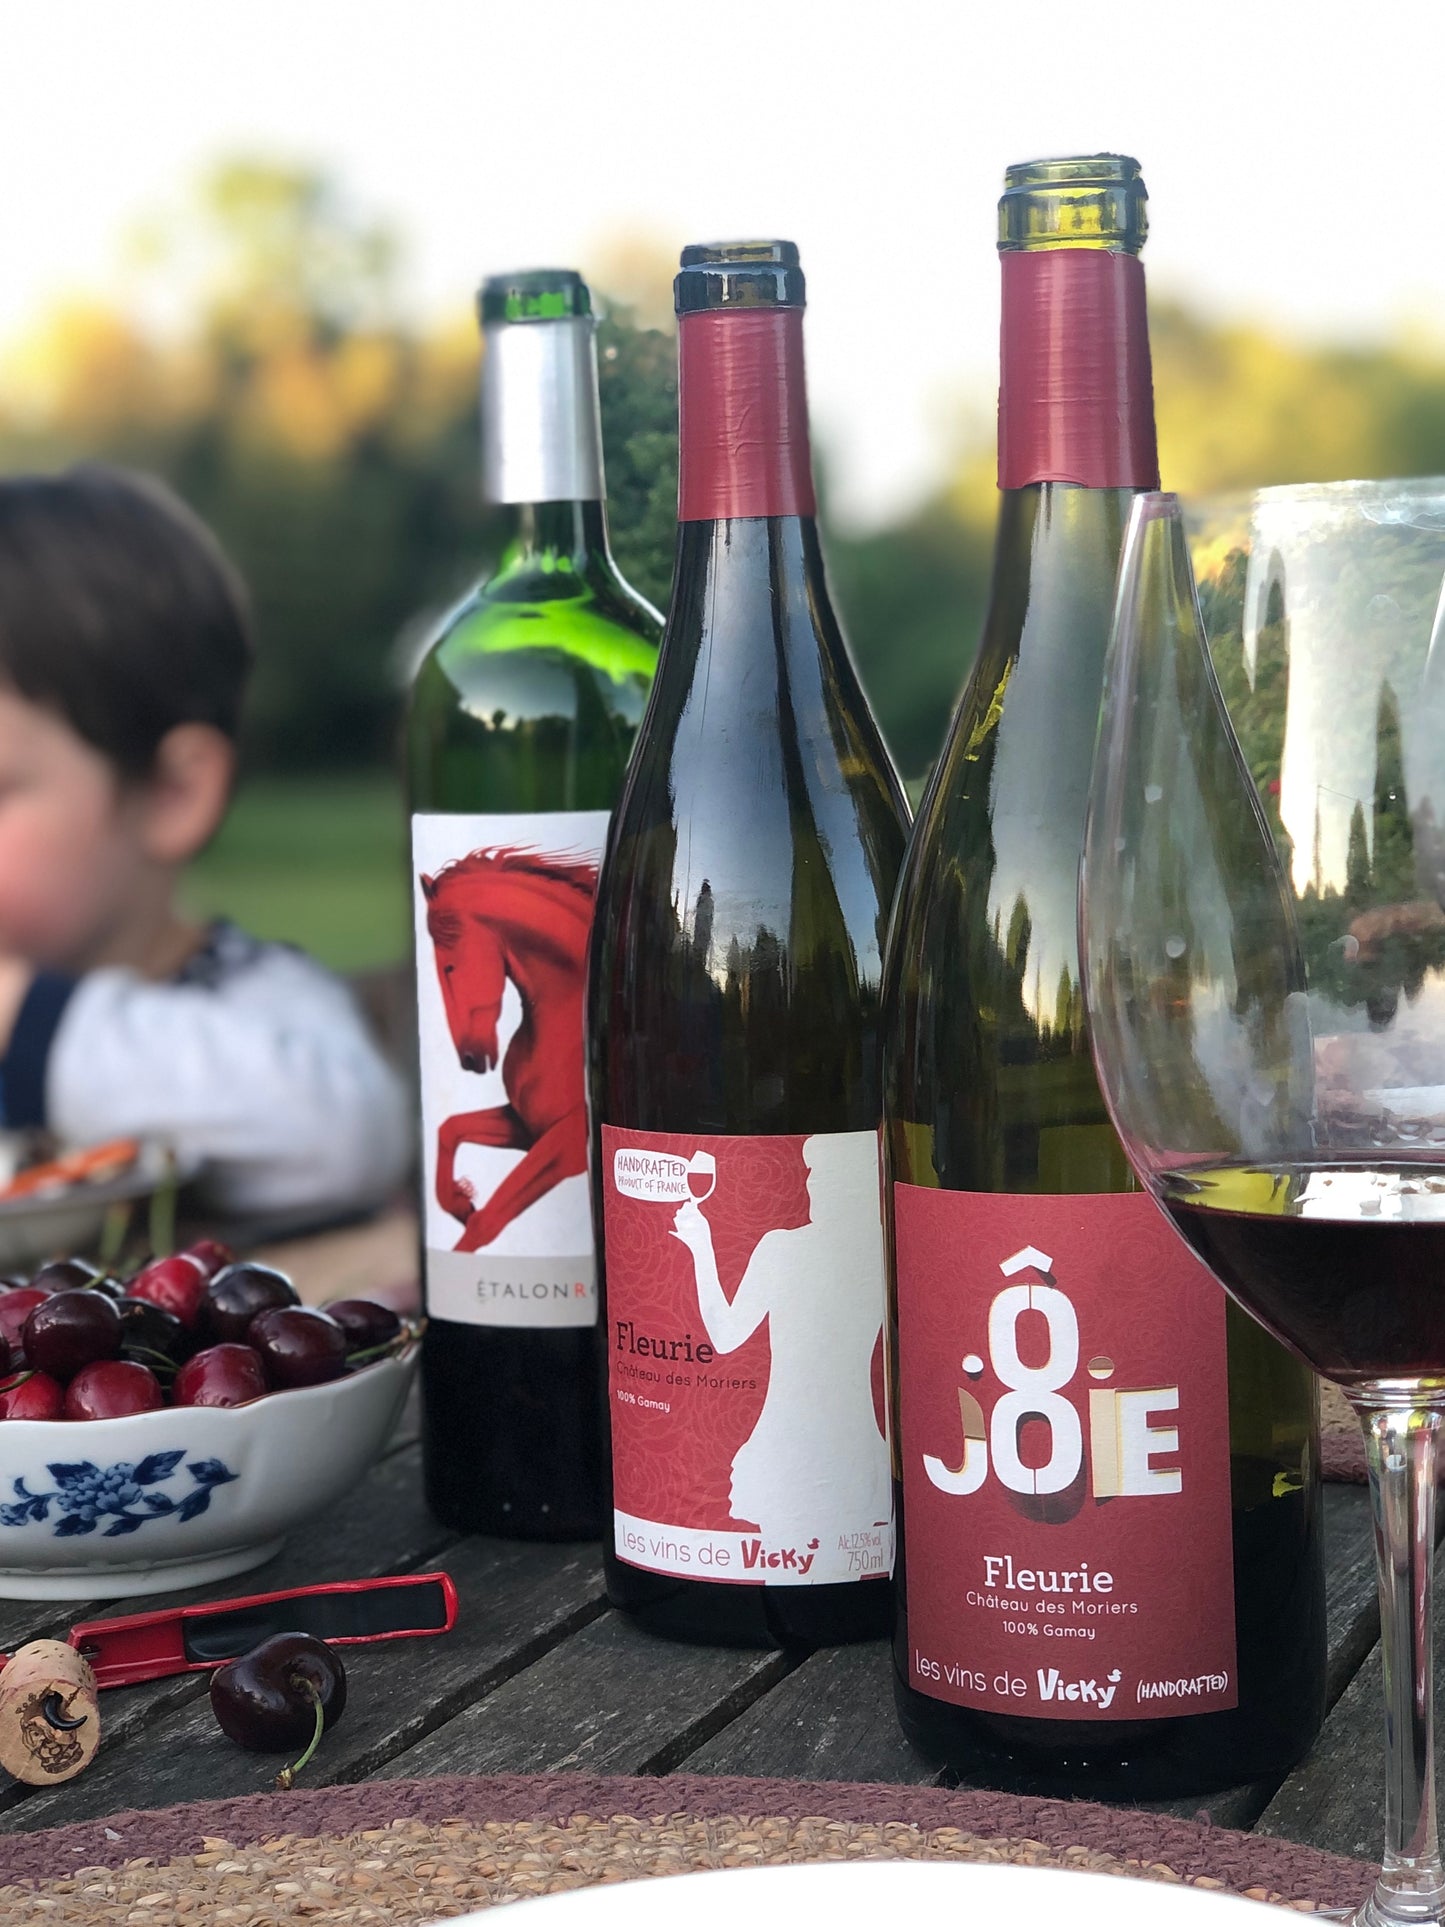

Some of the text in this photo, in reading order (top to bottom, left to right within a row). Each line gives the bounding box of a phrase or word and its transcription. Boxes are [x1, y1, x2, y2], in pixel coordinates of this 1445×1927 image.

[617, 1155, 687, 1178] HANDCRAFTED
[657, 1180, 687, 1195] FRANCE
[477, 1278, 596, 1299] ÉTALONR
[616, 1321, 714, 1364] Fleurie
[617, 1361, 757, 1390] Château des Moriers
[617, 1389, 671, 1413] 100% Gamay
[622, 1525, 646, 1554] les
[650, 1535, 691, 1563] vins
[698, 1542, 731, 1567] de
[983, 1555, 1114, 1593] Fleurie
[966, 1591, 1139, 1615] Château des Moriers
[1002, 1620, 1096, 1640] 100% Gamay
[915, 1649, 940, 1681] les
[943, 1662, 987, 1692] vins
[993, 1670, 1027, 1697] de
